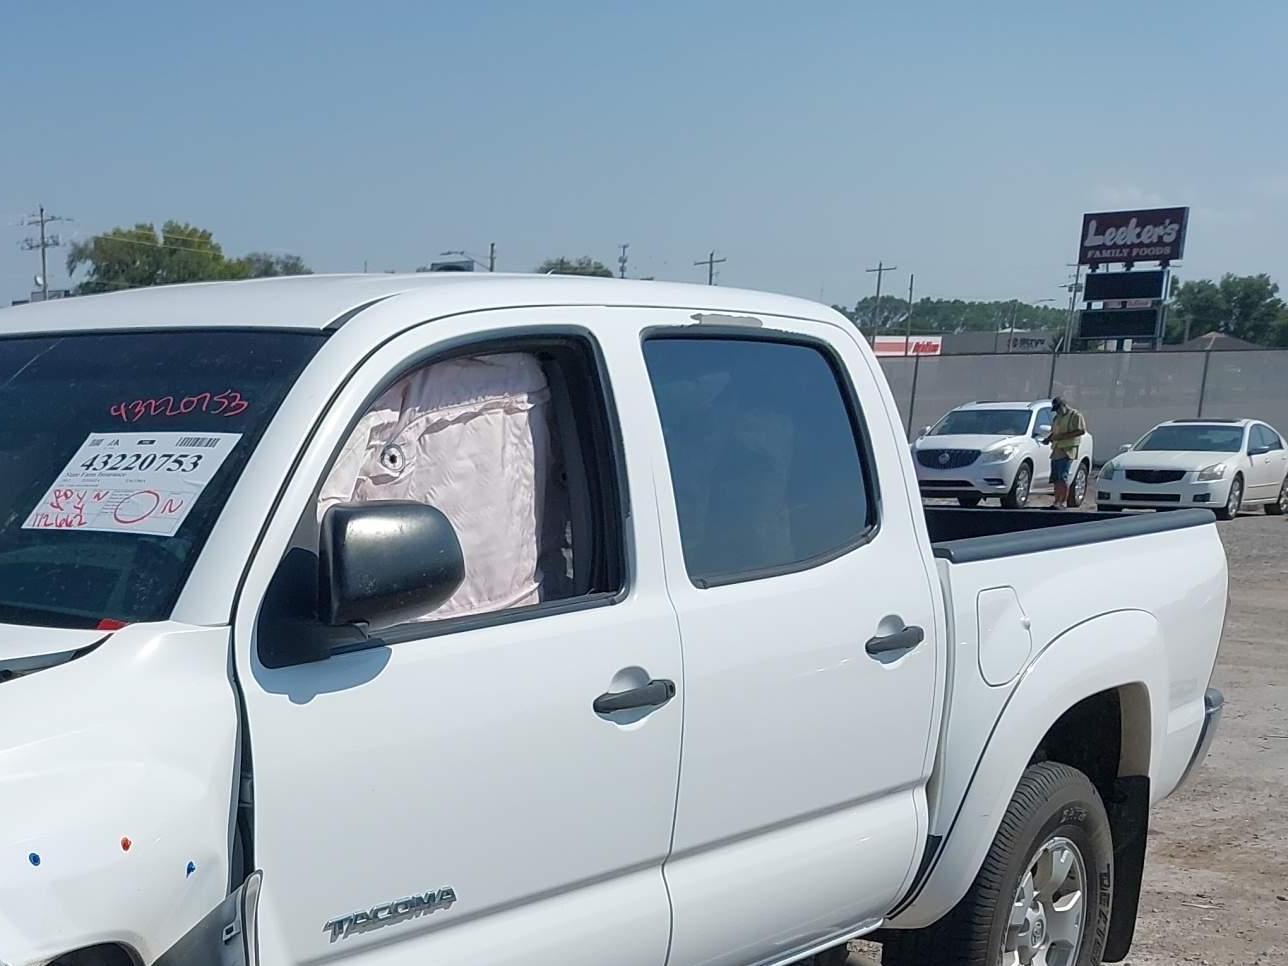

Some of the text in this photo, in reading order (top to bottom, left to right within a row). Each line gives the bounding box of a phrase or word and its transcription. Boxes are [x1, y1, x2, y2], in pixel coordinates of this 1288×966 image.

[1084, 218, 1179, 246] Leeker's
[1087, 246, 1171, 258] FAMILY FOODS
[110, 390, 249, 422] 43220753
[80, 453, 203, 472] 43220753
[323, 886, 457, 941] TACOMA
